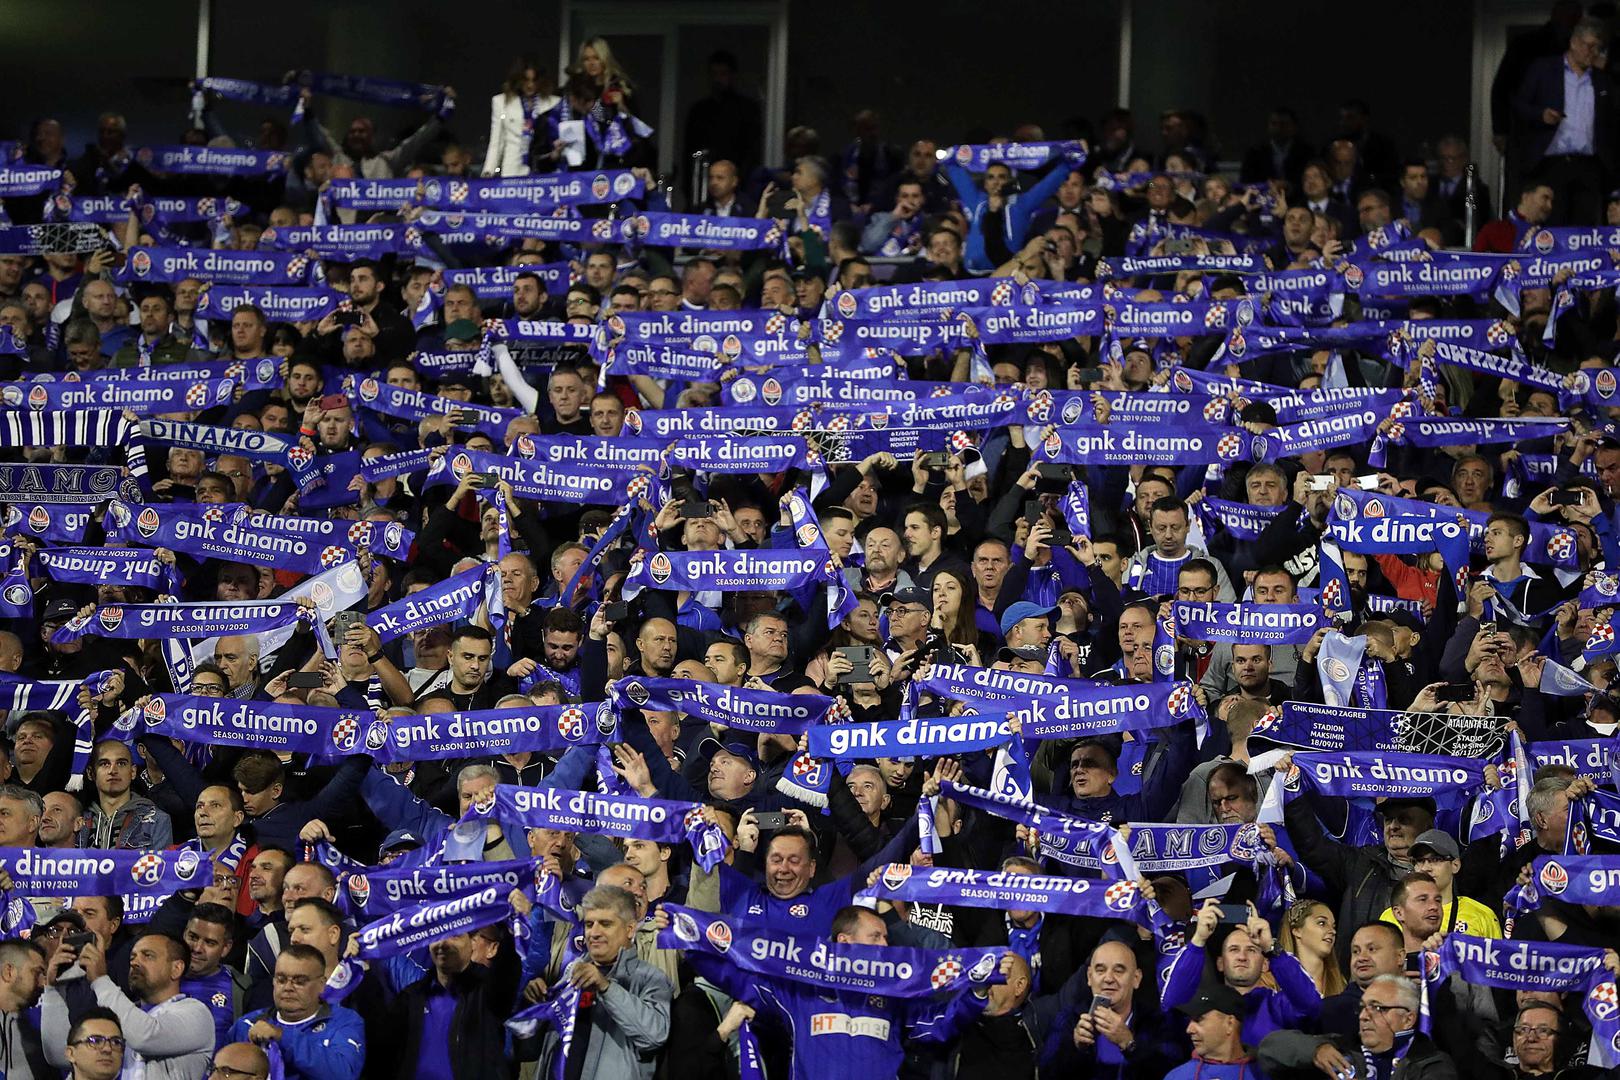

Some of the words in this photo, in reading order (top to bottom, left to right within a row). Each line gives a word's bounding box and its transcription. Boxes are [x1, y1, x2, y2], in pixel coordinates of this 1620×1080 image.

[163, 149, 193, 167] gnk
[197, 148, 257, 167] dinamo
[480, 187, 544, 203] dinamo
[549, 181, 581, 202] gnk
[83, 197, 115, 214] gnk
[289, 227, 324, 245] gnk
[328, 228, 394, 242] dinamo
[660, 222, 692, 239] gnk
[695, 219, 758, 239] dinamo
[1569, 230, 1603, 250] gnk
[163, 253, 199, 274] gnk
[204, 250, 275, 272] dinamo
[1122, 257, 1181, 272] dinamo
[1254, 274, 1326, 291] dinamo
[1377, 266, 1413, 286] gnk
[1419, 265, 1492, 282] dinamo
[221, 291, 257, 313] gnk
[261, 291, 329, 310] dinamo
[869, 290, 902, 312] gnk
[909, 288, 979, 306] dinamo
[986, 311, 1020, 334] gnk
[1026, 306, 1096, 328] dinamo
[1121, 306, 1193, 323] dinamo
[517, 321, 566, 337] GNK
[639, 316, 673, 337] gnk
[676, 317, 753, 334] dinamo
[857, 325, 931, 343] dinamo
[755, 334, 788, 356] gnk
[626, 345, 657, 364] gnk
[660, 348, 723, 370] dinamo
[1436, 342, 1524, 378] DINAMO
[137, 367, 211, 381] dinamo
[61, 384, 96, 408] gnk
[101, 384, 174, 403] dinamo
[391, 387, 425, 407] gnk
[796, 382, 840, 404] gnk
[844, 382, 916, 401] dinamo
[1111, 392, 1190, 413] dinamo
[1268, 390, 1306, 413] gnk
[1311, 386, 1387, 405] dinamo
[1296, 406, 1324, 416] SEASON
[1325, 400, 1362, 413] 2019/2020
[657, 411, 693, 435] gnk
[696, 410, 778, 430] dinamo
[956, 418, 990, 427] 2019/2020
[1298, 412, 1376, 439] dinamo
[150, 421, 265, 450] DINAMO
[1077, 430, 1114, 453] gnk
[1122, 431, 1203, 452] dinamo
[1285, 441, 1312, 452] SEASON
[1313, 433, 1351, 447] 2019/2020
[549, 444, 587, 465] gnk
[674, 439, 711, 461] gnk
[718, 440, 796, 460] dinamo
[1139, 453, 1174, 461] 2019/2020
[373, 463, 397, 475] SEASON
[735, 461, 769, 469] 2019/2020
[535, 463, 613, 492] dinamo
[514, 485, 542, 494] SEASON
[544, 487, 583, 498] 2019/2020
[250, 514, 334, 534] dinamo
[176, 518, 217, 540] gnk
[223, 528, 307, 555] dinamo
[70, 547, 105, 556] 2019/2020
[201, 542, 231, 554] SEASON
[233, 547, 275, 561] 2019/2020
[40, 555, 117, 579] dinamo
[122, 560, 161, 579] gnk
[687, 553, 729, 578] gnk
[735, 552, 815, 574] dinamo
[716, 578, 745, 586] SEASON
[746, 577, 786, 585] 2019/2020
[405, 580, 482, 621] dinamo
[141, 606, 184, 627] gnk
[424, 608, 463, 627] 2019/2020
[1178, 604, 1218, 625] gnk
[1226, 604, 1317, 627] dinamo
[171, 625, 205, 633] SEASON
[206, 623, 249, 632] 2019/2020
[1206, 627, 1238, 637] SEASON
[1240, 630, 1285, 639] 2019/2020
[924, 663, 971, 684] gnk
[975, 666, 1069, 695] dinamo
[667, 685, 710, 705] gnk
[717, 689, 809, 719] dinamo
[950, 685, 984, 698] SEASON
[700, 706, 730, 719] SEASON
[731, 716, 776, 728] 2019/2020
[1054, 694, 1150, 721] dinamo
[1292, 705, 1308, 714] GNK
[1309, 706, 1337, 717] DINAMO
[1339, 709, 1367, 719] ZAGREB
[183, 703, 225, 729] gnk
[232, 703, 318, 735] dinamo
[395, 717, 440, 744] gnk
[448, 713, 541, 739] dinamo
[1034, 725, 1069, 735] SEASON
[1070, 718, 1118, 731] 2019/2020
[1313, 722, 1344, 733] STADION
[212, 730, 243, 741] SEASON
[245, 733, 288, 744] 2019/2020
[430, 740, 463, 752] SEASON
[464, 739, 511, 750] 2019/2020
[830, 721, 887, 754] gnk
[896, 717, 1010, 745] dinamo
[1310, 731, 1345, 741] MAKSIMIR
[1310, 739, 1343, 749] 18/09/19
[1375, 742, 1421, 752] CHAMPIONS
[1316, 758, 1363, 785] gnk
[1371, 757, 1468, 785] dinamo
[1351, 782, 1385, 793] SEASON
[1386, 784, 1433, 795] 2019/2020
[515, 787, 562, 816] gnk
[569, 791, 666, 824] dinamo
[548, 814, 583, 826] SEASON
[584, 818, 632, 832] 2019/2020
[15, 849, 115, 877] dinamo
[31, 880, 79, 889] 2019/2020
[386, 871, 428, 901] gnk
[927, 870, 981, 888] gnk
[987, 869, 1089, 894] dinamo
[960, 888, 998, 900] SEASON
[998, 892, 1048, 904] 2019/2020
[363, 917, 403, 949] gnk
[409, 887, 497, 928] dinamo
[396, 933, 427, 947] SEASON
[429, 915, 473, 938] 2019/2020
[751, 937, 802, 963] gnk
[809, 943, 914, 980] dinamo
[1453, 940, 1500, 966] gnk
[785, 966, 824, 980] SEASON
[825, 973, 875, 988] 2019/2020
[1485, 968, 1524, 983] SEASON
[813, 1016, 837, 1033] HT
